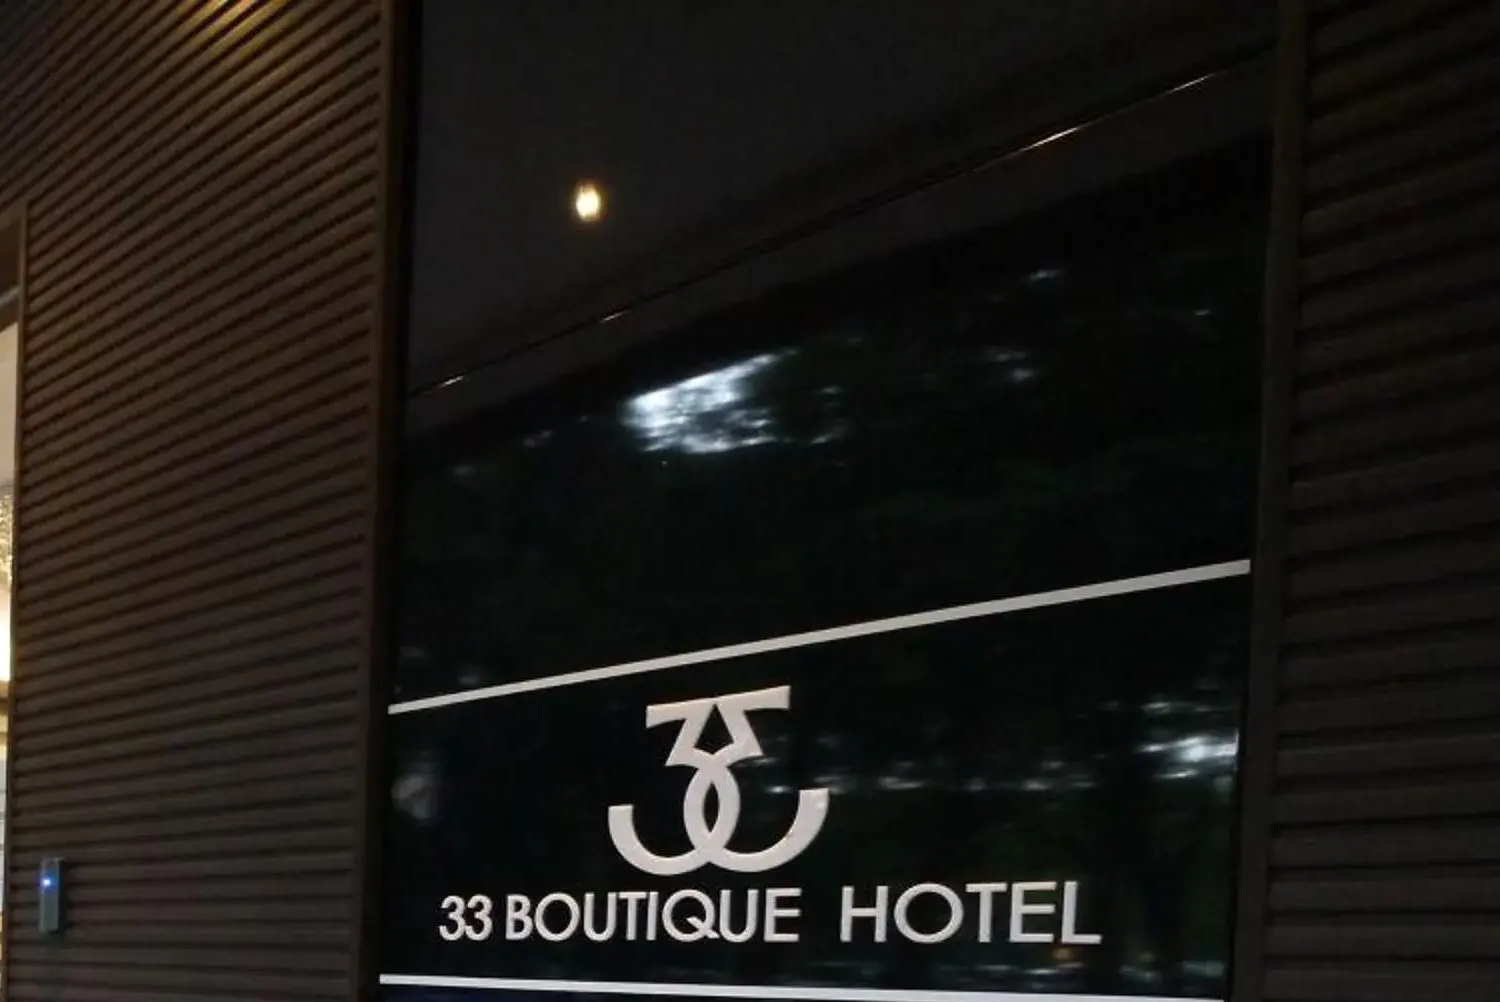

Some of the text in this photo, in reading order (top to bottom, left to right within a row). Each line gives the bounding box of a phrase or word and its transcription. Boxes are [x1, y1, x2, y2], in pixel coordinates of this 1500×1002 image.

[438, 880, 1102, 944] 33 BOUTIQUE HOTEL
